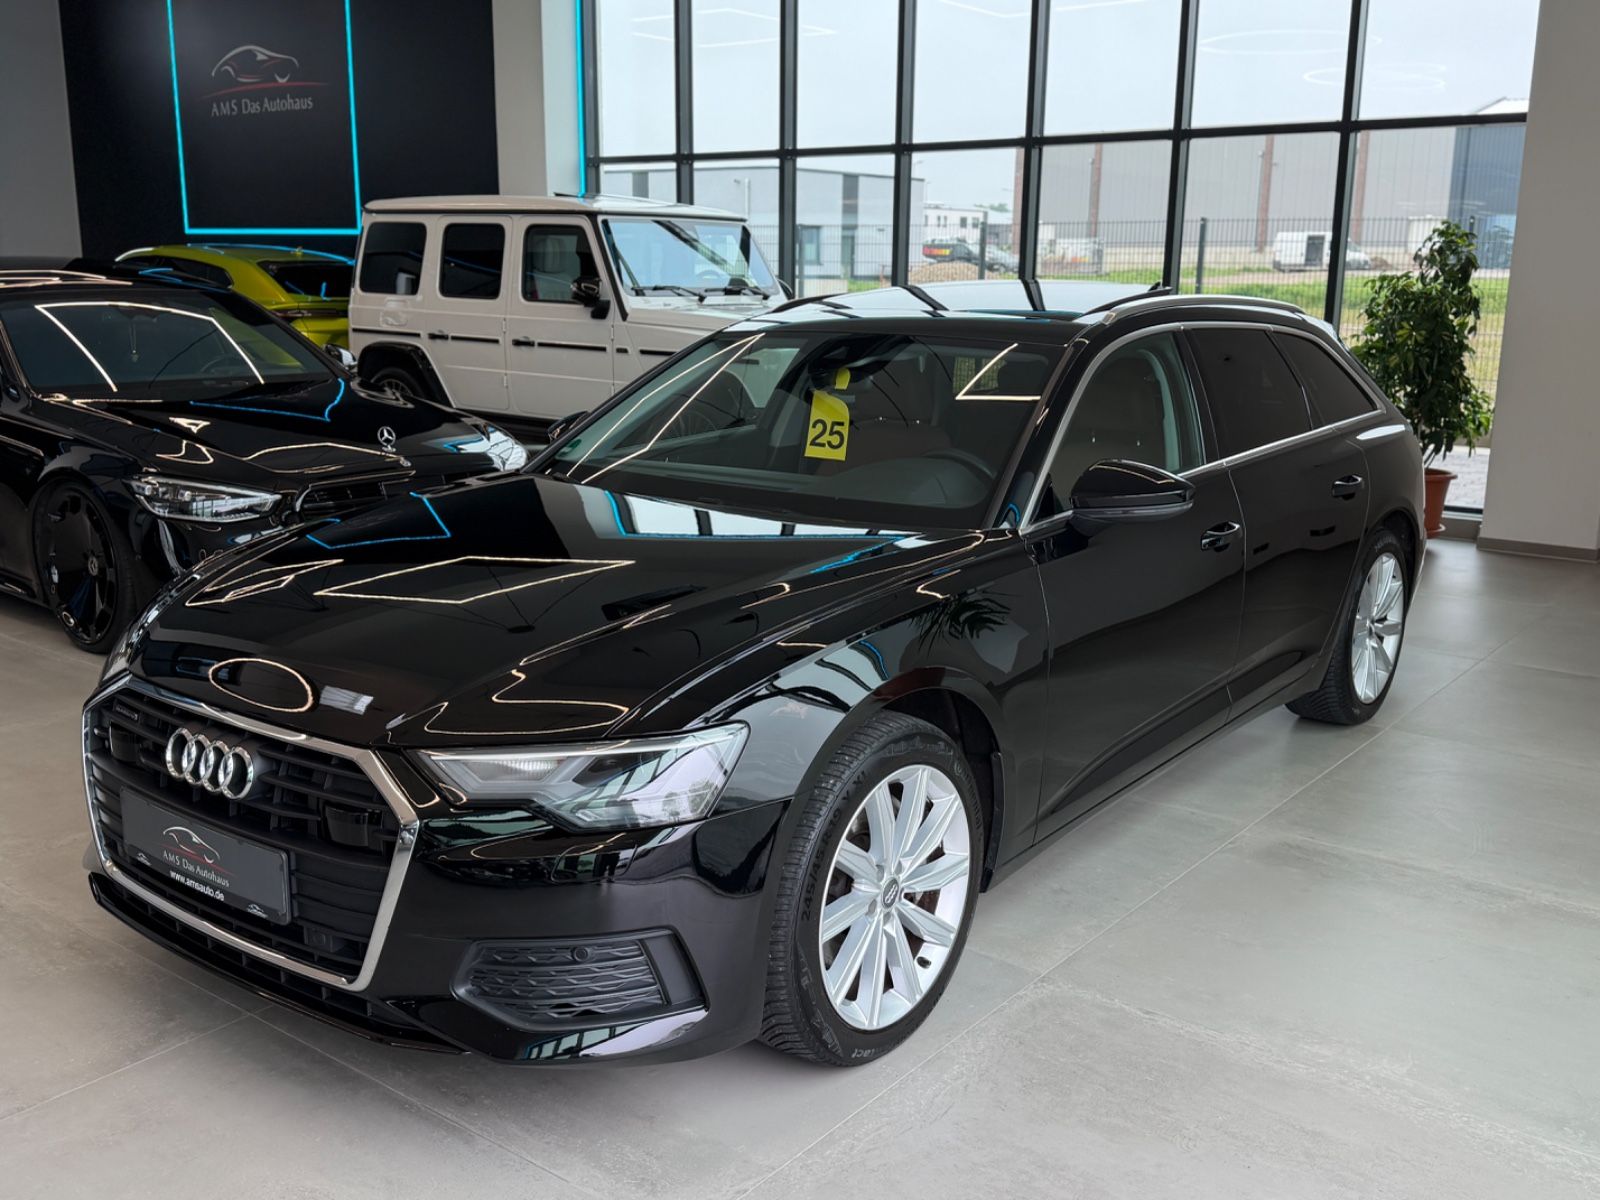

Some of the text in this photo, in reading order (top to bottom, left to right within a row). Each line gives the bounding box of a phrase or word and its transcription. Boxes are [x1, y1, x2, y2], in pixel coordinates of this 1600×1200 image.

[211, 94, 313, 117] AMS Das Autohaus
[809, 418, 845, 450] 25
[163, 850, 231, 888] AMS Das Autohaus
[169, 870, 225, 902] www.amsauto.de
